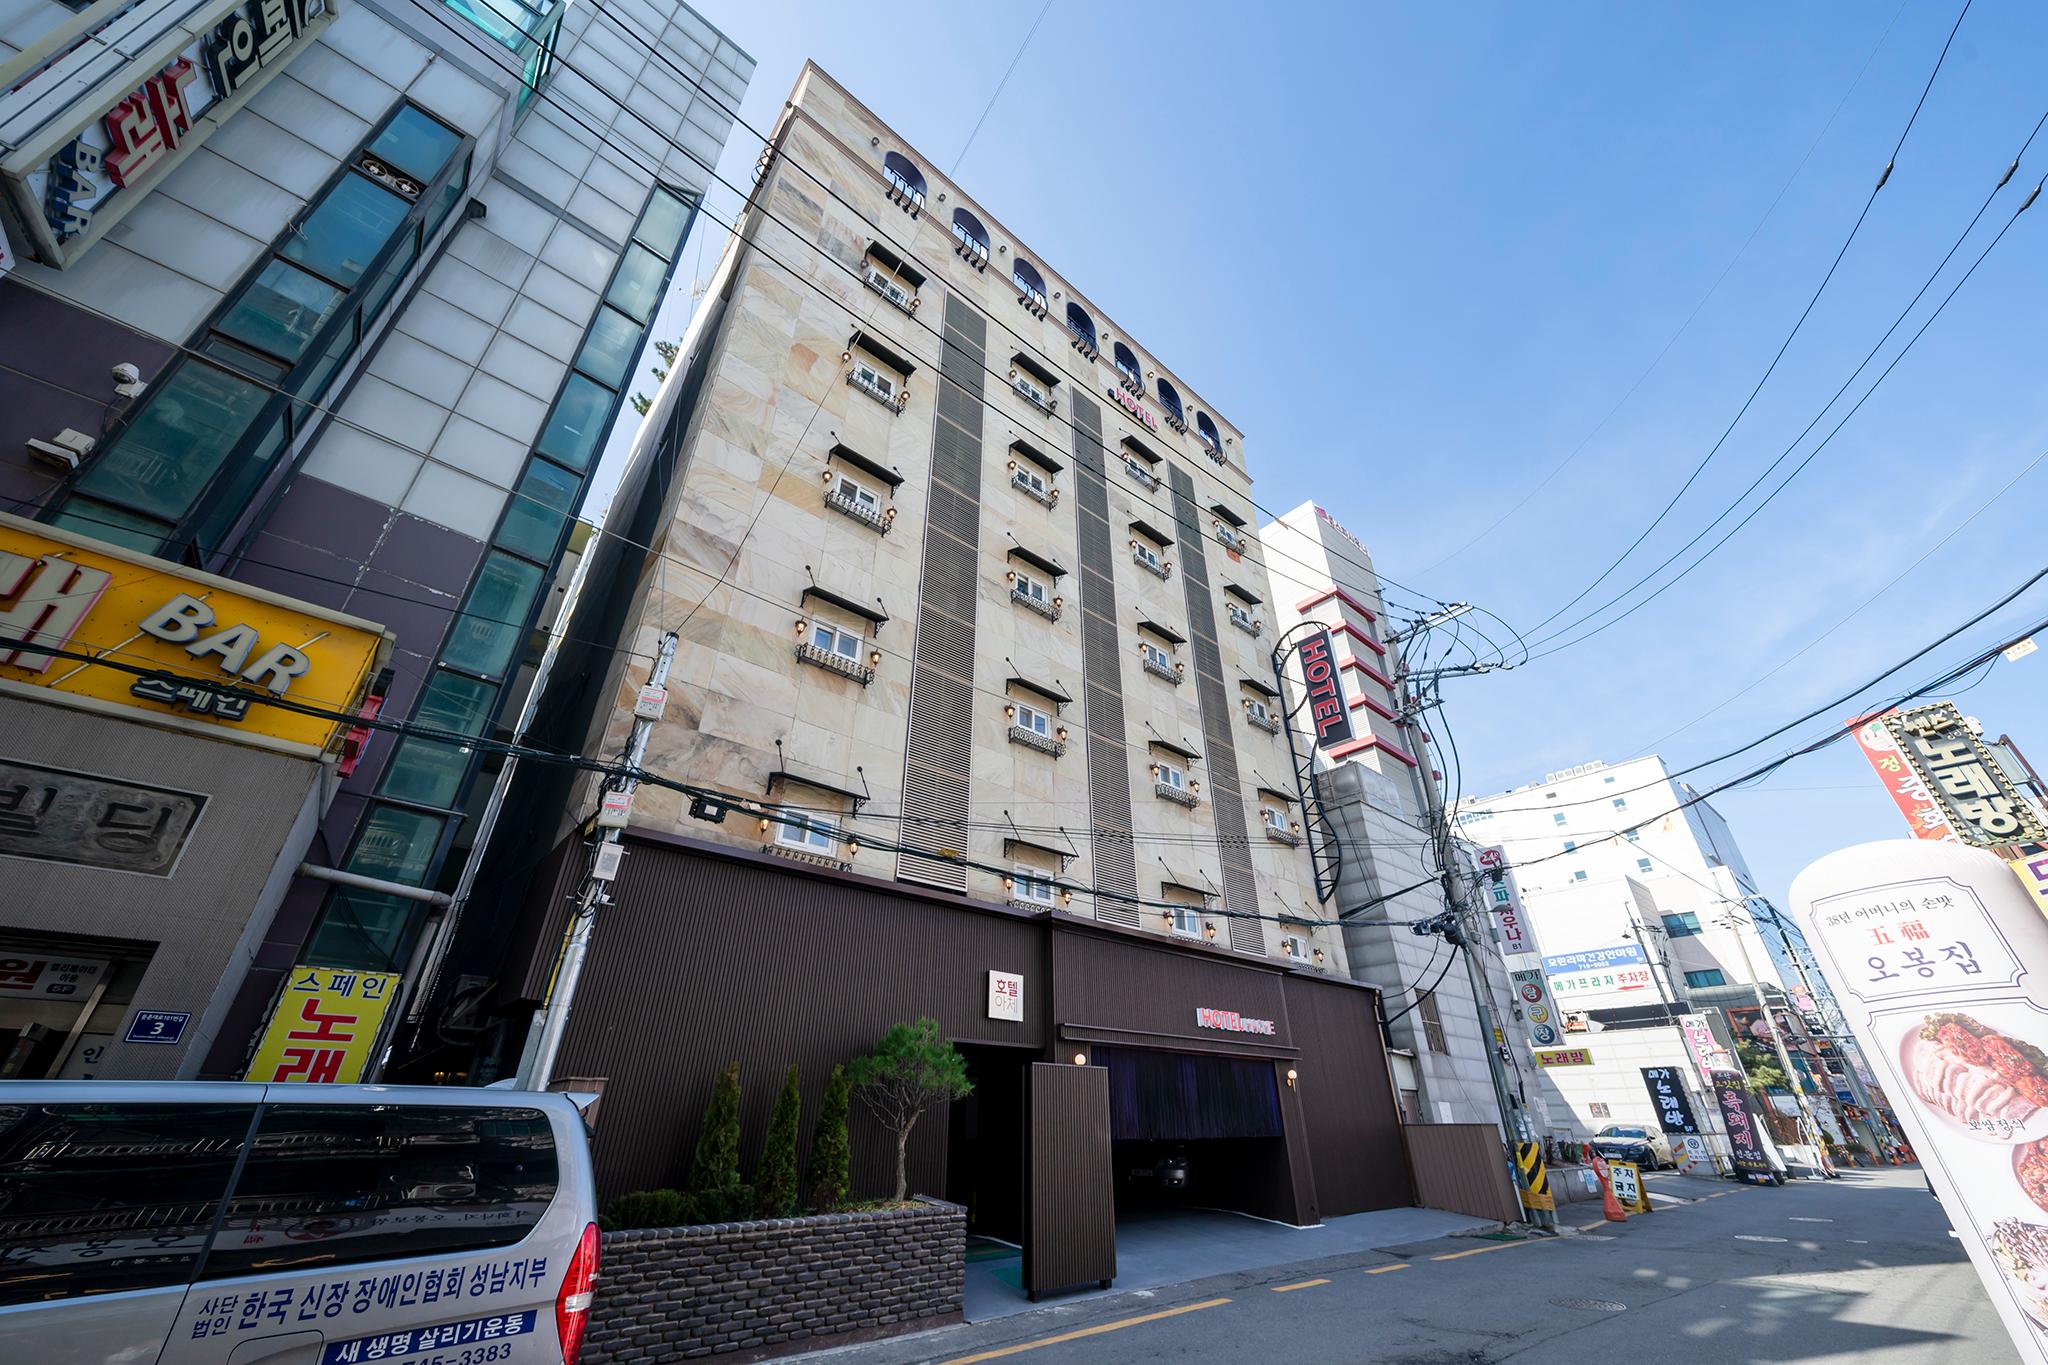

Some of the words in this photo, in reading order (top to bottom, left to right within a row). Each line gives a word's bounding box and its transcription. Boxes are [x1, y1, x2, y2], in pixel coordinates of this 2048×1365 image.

[58, 140, 103, 238] BAR
[1115, 387, 1159, 430] HOTEL
[139, 593, 311, 696] BAR
[1301, 638, 1343, 738] HOTEL
[1915, 738, 2019, 834] 노래방
[1826, 911, 1852, 928] 38년
[1855, 899, 1917, 920] 어머니의
[1921, 894, 1956, 911] 손맛
[1867, 919, 1931, 947] 五福
[1868, 940, 1982, 982] 오봉집
[293, 972, 387, 1000] 스페인
[995, 978, 1018, 998] 호텔
[1514, 972, 1539, 982] 메가
[1617, 970, 1649, 984] 주차장
[150, 1021, 165, 1035] 3
[1196, 1007, 1243, 1031] HOTEL
[1540, 1051, 1584, 1065] 노래방
[1648, 1068, 1670, 1079] 메가
[1656, 1079, 1684, 1125] 노래방
[1722, 1090, 1753, 1151] 흑돼지
[1613, 1167, 1634, 1179] 주차
[1614, 1181, 1637, 1194] 금지
[198, 1294, 240, 1316] 사단
[238, 1288, 295, 1331] 한국
[297, 1280, 350, 1322] 신장
[352, 1266, 466, 1314] 장애인협회
[469, 1257, 548, 1298] 성남지부
[191, 1315, 232, 1340] 법인
[335, 1340, 362, 1363] 새
[366, 1332, 413, 1359] 생명
[418, 1313, 524, 1351] 살리기운동
